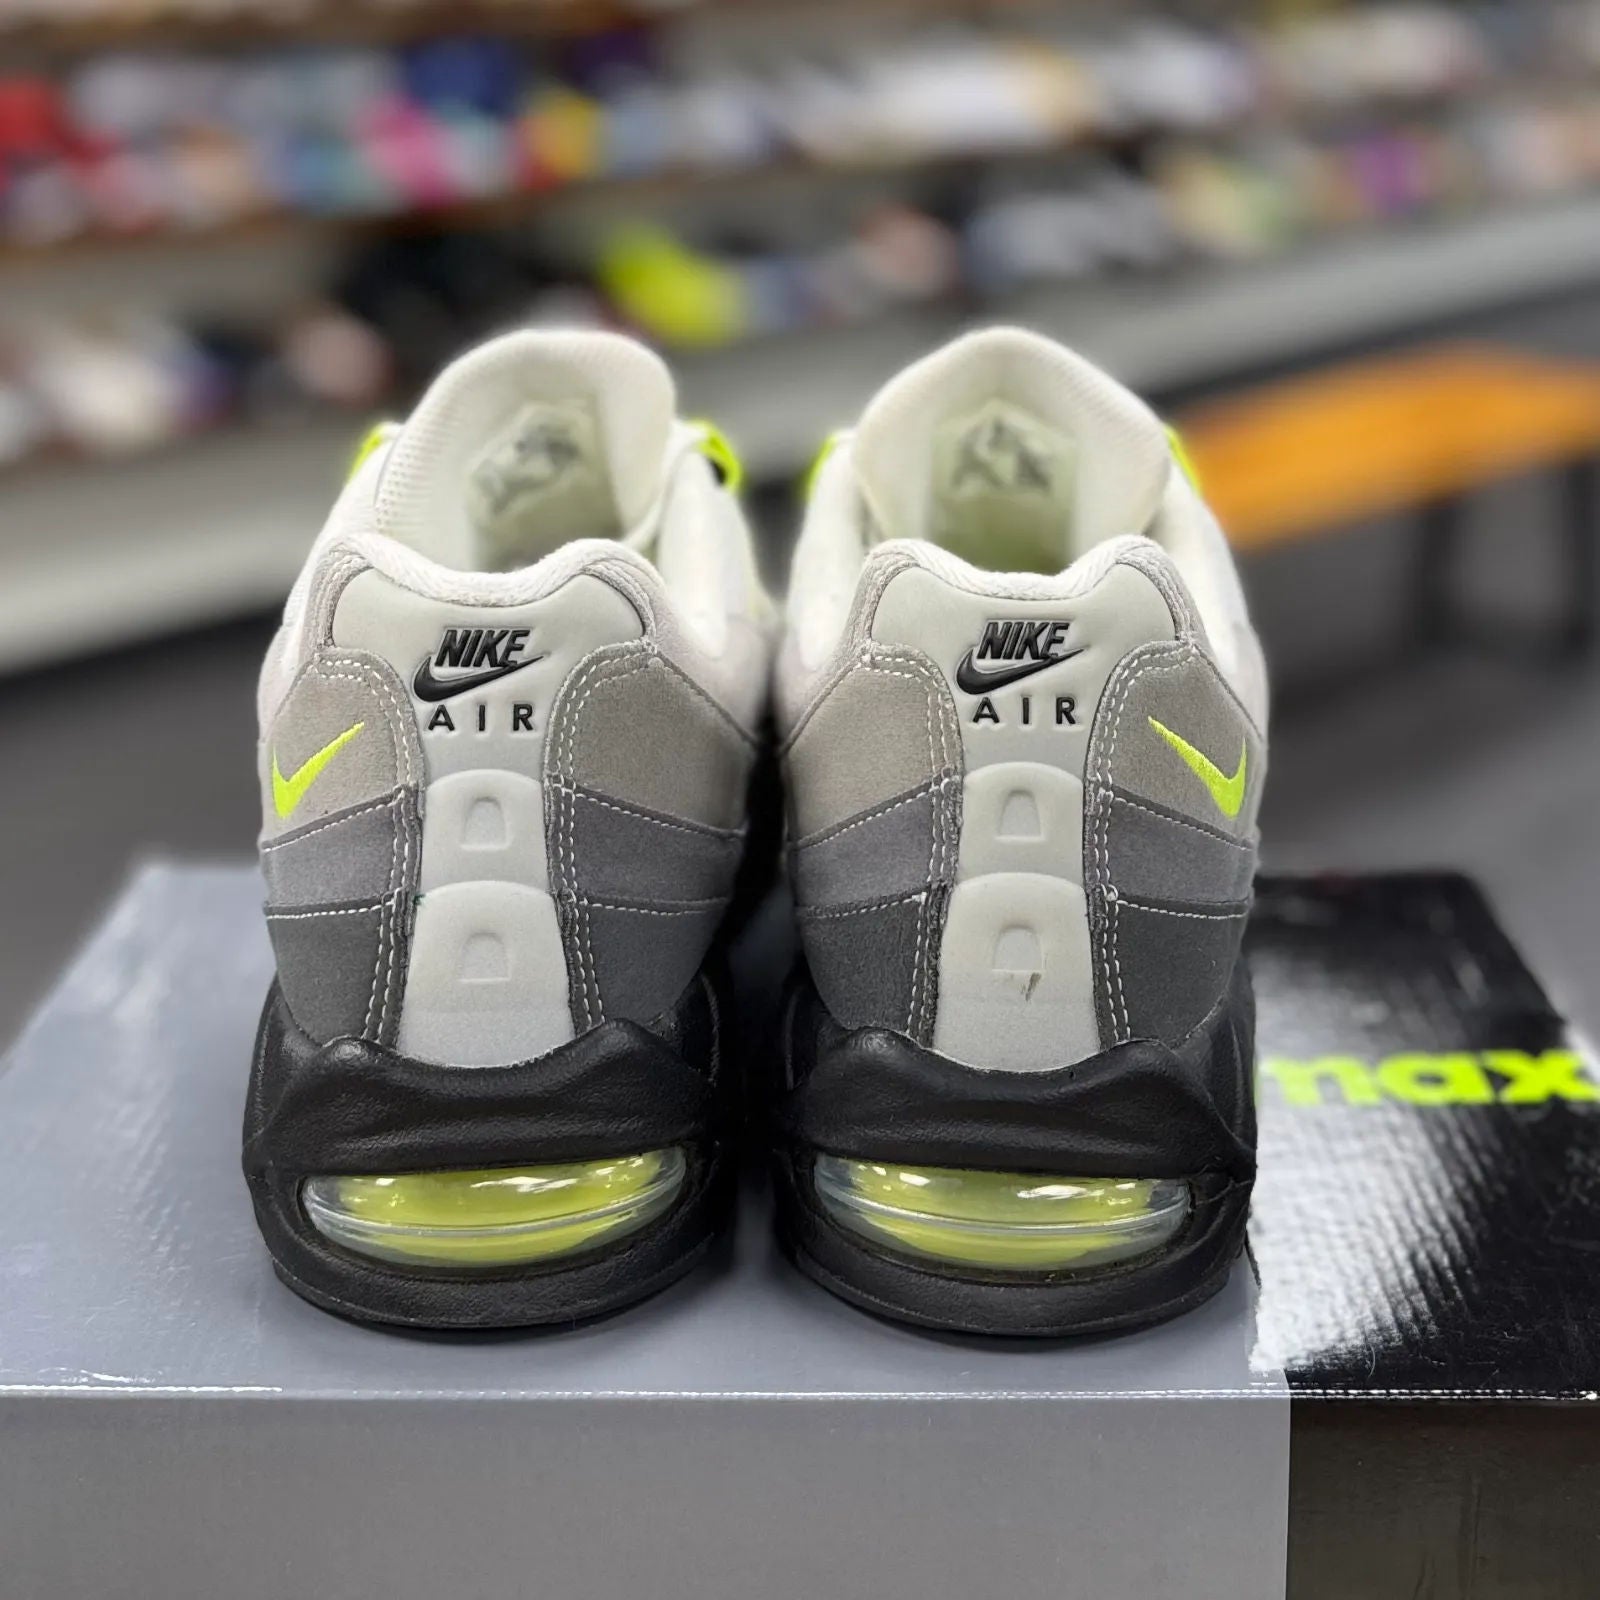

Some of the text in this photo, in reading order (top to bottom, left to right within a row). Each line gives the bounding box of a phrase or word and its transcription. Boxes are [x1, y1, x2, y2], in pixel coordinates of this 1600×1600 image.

[434, 629, 531, 668] NIKE
[976, 621, 1070, 661] NIKE
[427, 703, 534, 732] AIR
[972, 696, 1076, 725] AIR
